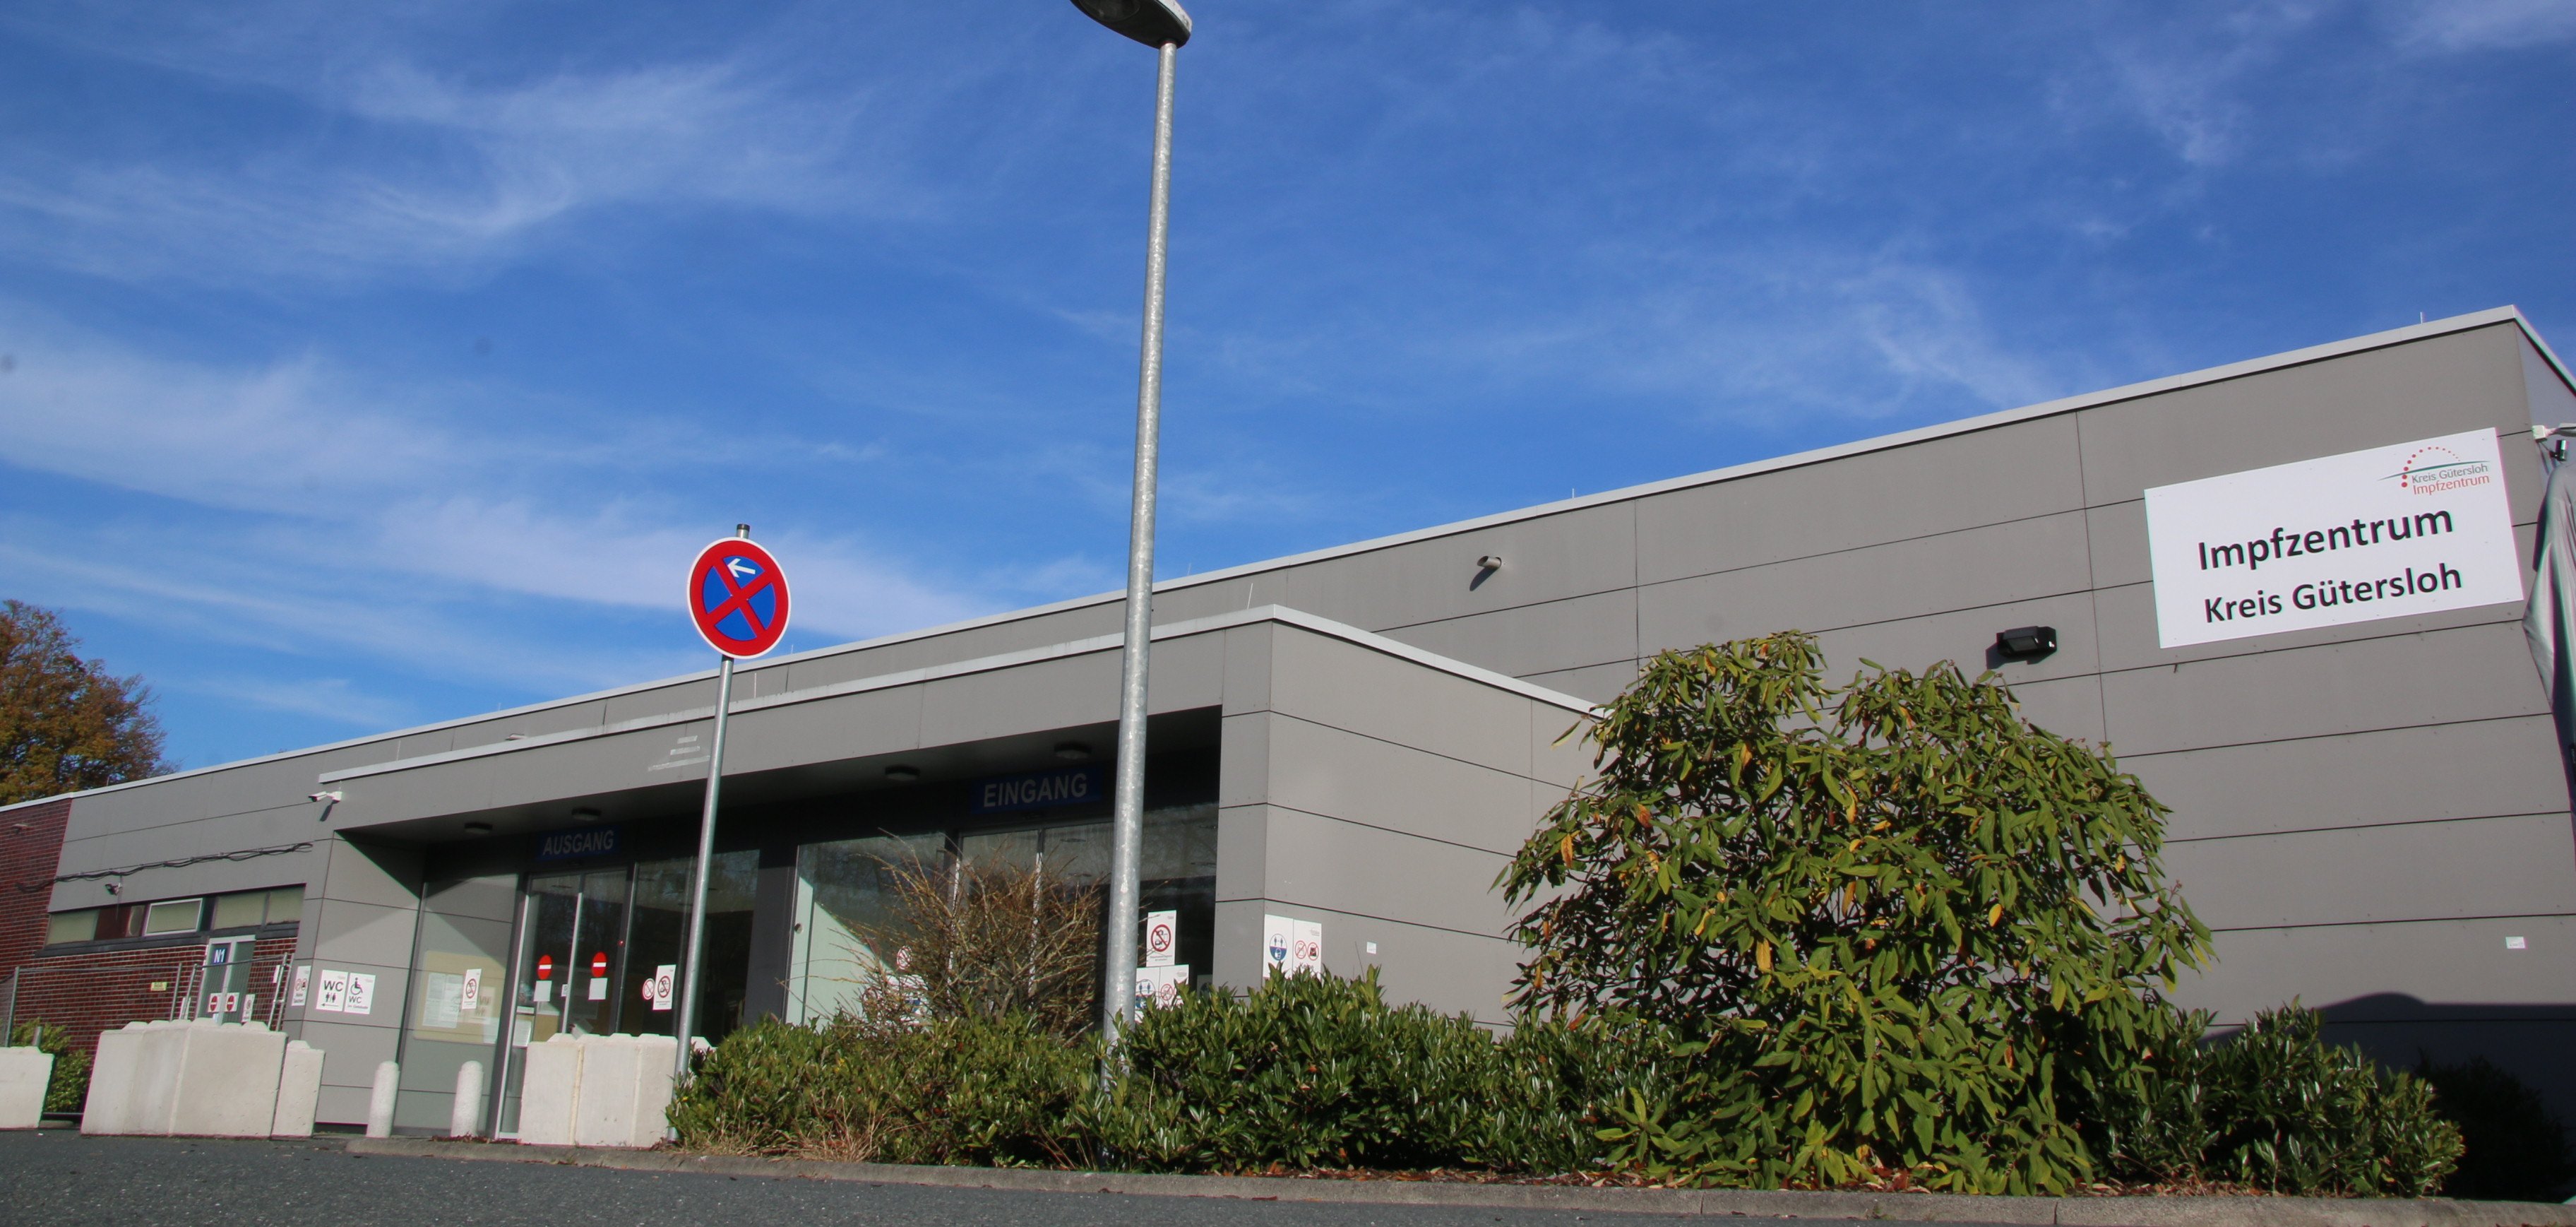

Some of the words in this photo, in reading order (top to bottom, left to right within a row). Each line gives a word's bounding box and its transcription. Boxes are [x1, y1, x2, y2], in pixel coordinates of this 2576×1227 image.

[2411, 473, 2436, 484] Kreis
[2438, 463, 2488, 480] Gütersloh
[2412, 475, 2490, 495] Impfzentrum
[2198, 509, 2453, 570] Impfzentrum
[2205, 590, 2282, 623] Kreis
[2292, 562, 2462, 610] Gütersloh
[983, 772, 1087, 807] EINGANG
[542, 829, 614, 856] AUSGANG
[213, 948, 226, 964] N1
[323, 980, 344, 992] WC
[348, 995, 362, 1004] WC
